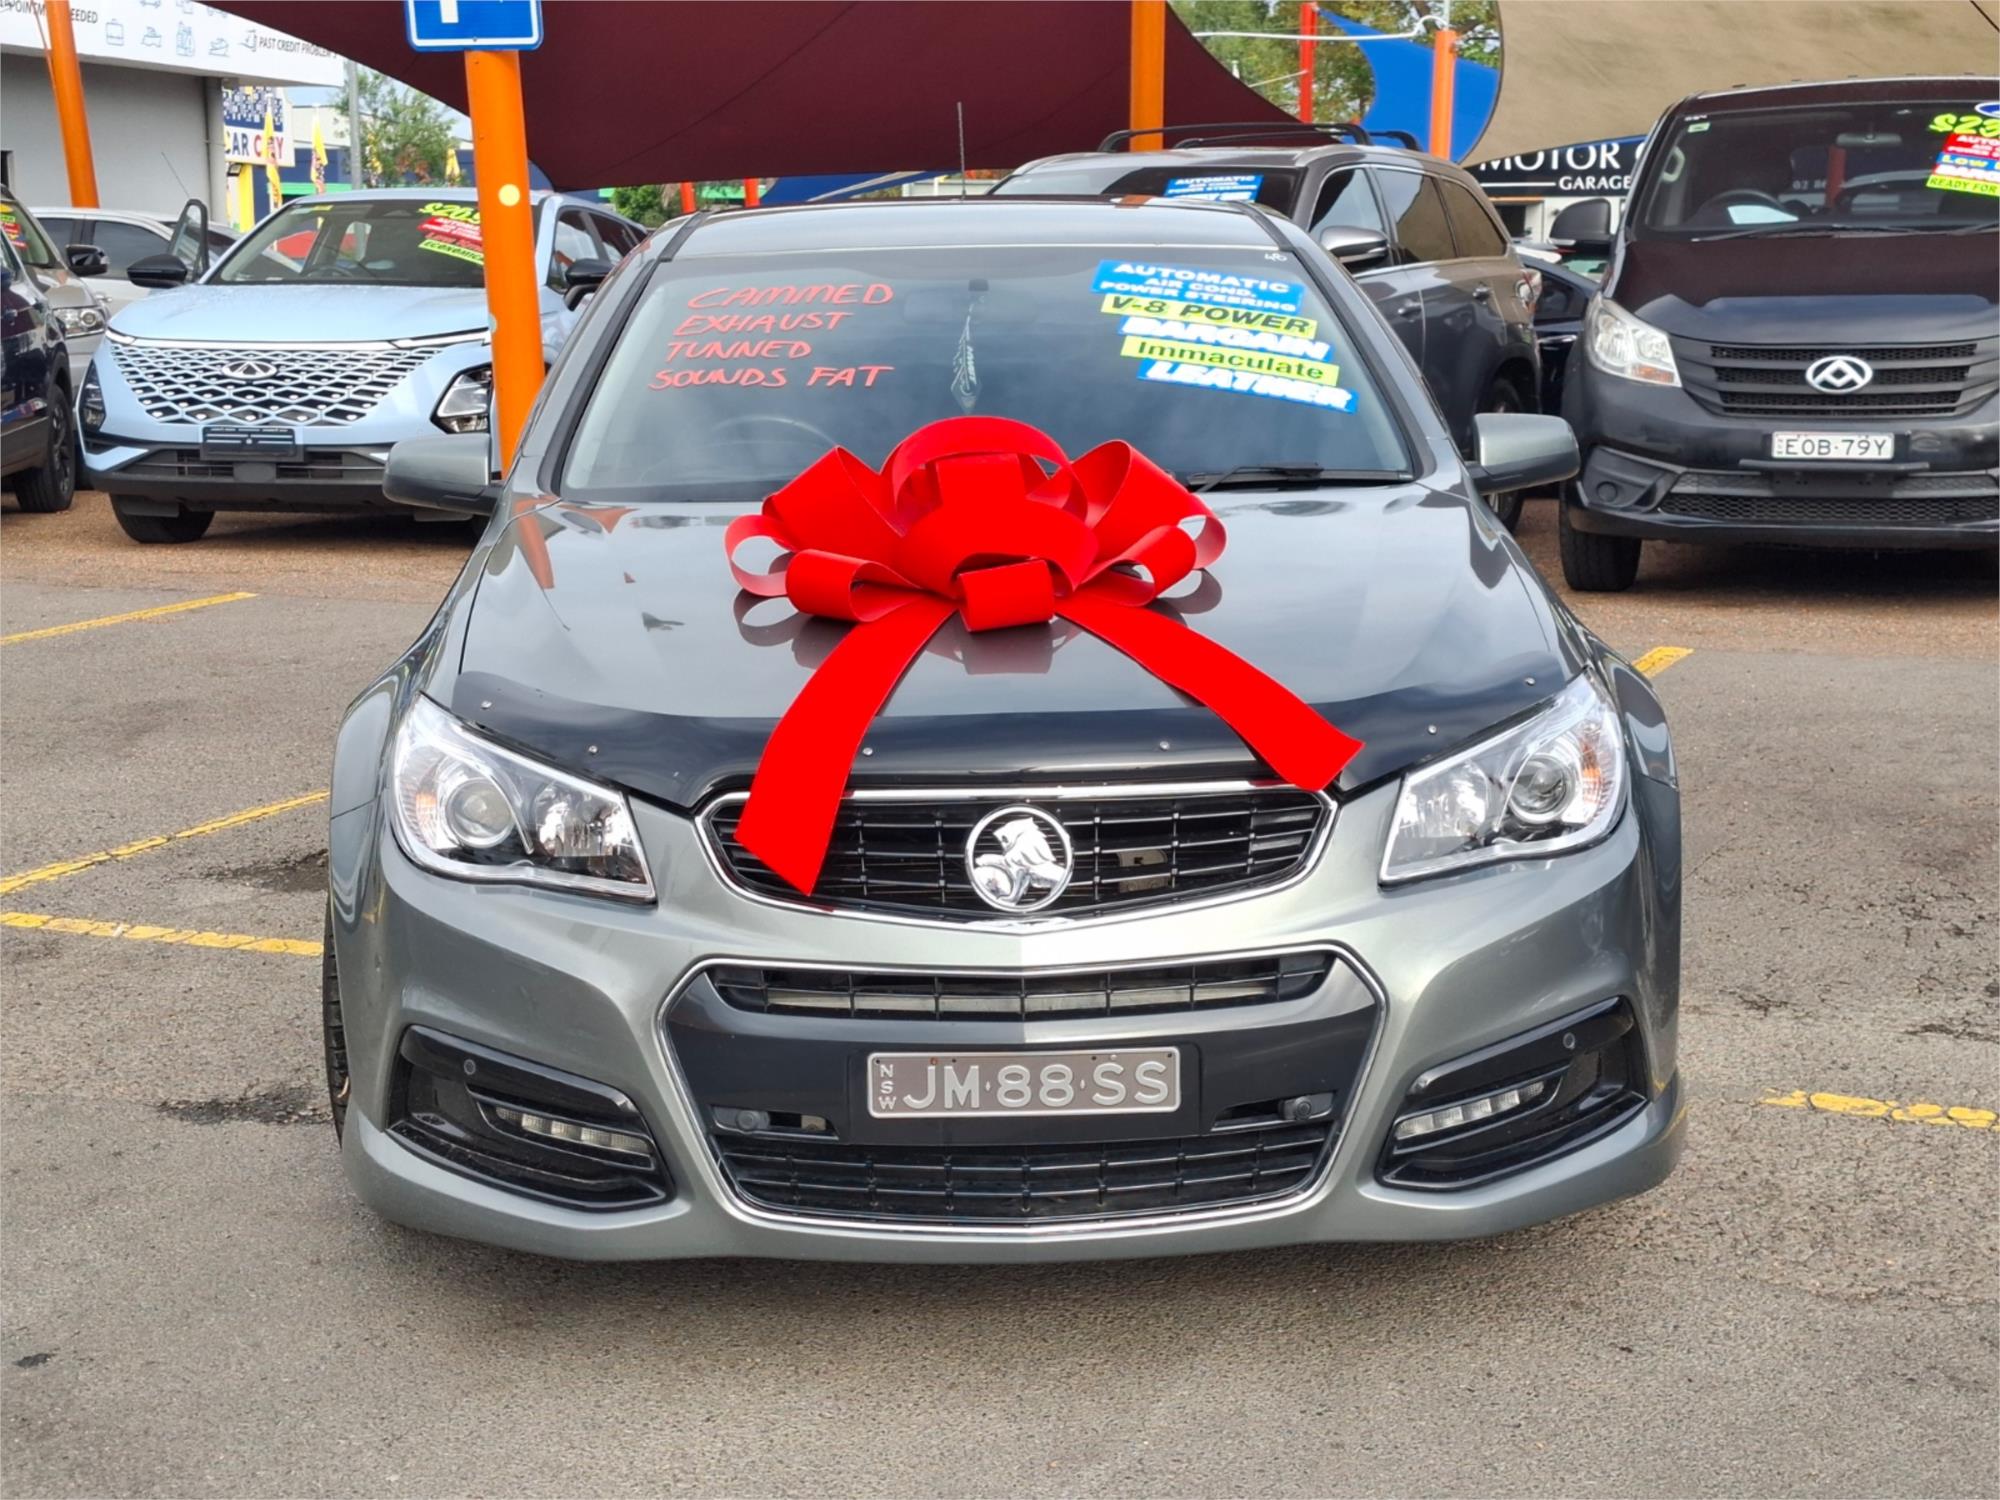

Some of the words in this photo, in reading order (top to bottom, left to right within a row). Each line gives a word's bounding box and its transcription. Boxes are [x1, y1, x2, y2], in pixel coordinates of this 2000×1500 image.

[70, 8, 98, 24] EEDED
[1559, 175, 1632, 191] GARAGE
[1930, 178, 1968, 190] READY
[1972, 182, 1998, 194] FOR
[1113, 263, 1290, 294] AUTOMATIC
[1145, 278, 1184, 290] AIR
[1189, 282, 1257, 298] COND.
[688, 283, 895, 310] CAMMED
[1100, 281, 1179, 298] POWER
[1184, 290, 1297, 312] STEERING
[673, 311, 855, 336] EXHAUST
[1112, 296, 1168, 314] V-8
[1179, 304, 1311, 334] POWER
[1121, 316, 1330, 360] BARGAIN
[665, 340, 812, 363] TUNNED
[1138, 341, 1324, 381] Immaculate
[648, 367, 788, 390] SOUNDS
[805, 366, 895, 388] FAT
